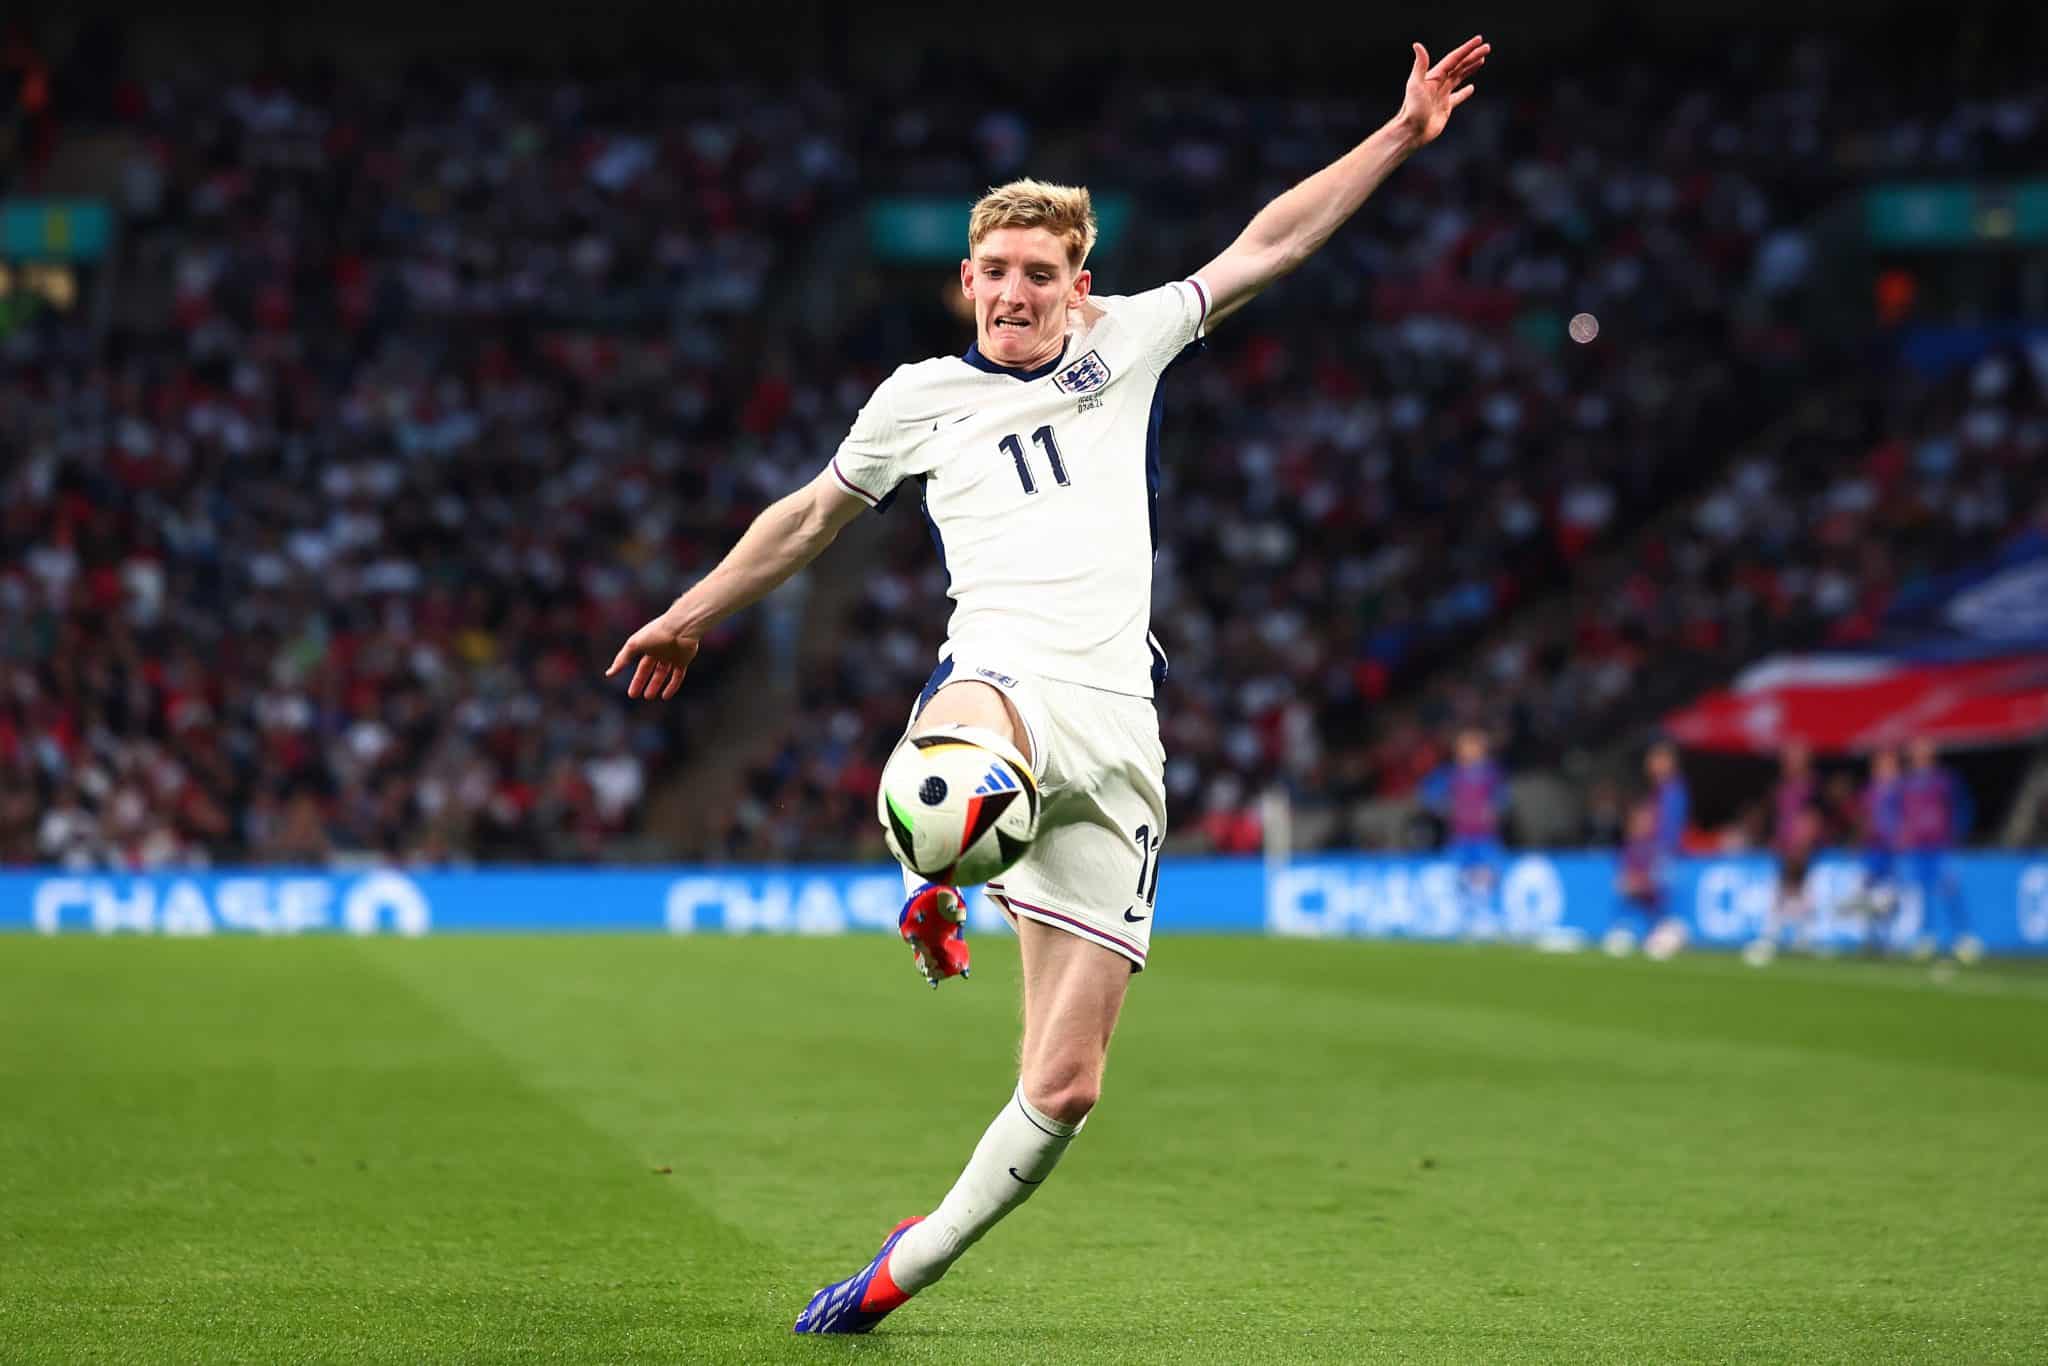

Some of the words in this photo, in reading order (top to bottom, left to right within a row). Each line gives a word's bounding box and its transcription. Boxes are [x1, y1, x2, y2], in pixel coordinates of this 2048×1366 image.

[998, 424, 1071, 495] 11
[1135, 824, 1159, 908] 11
[34, 877, 332, 937] CHASE
[667, 876, 902, 937] CHAS
